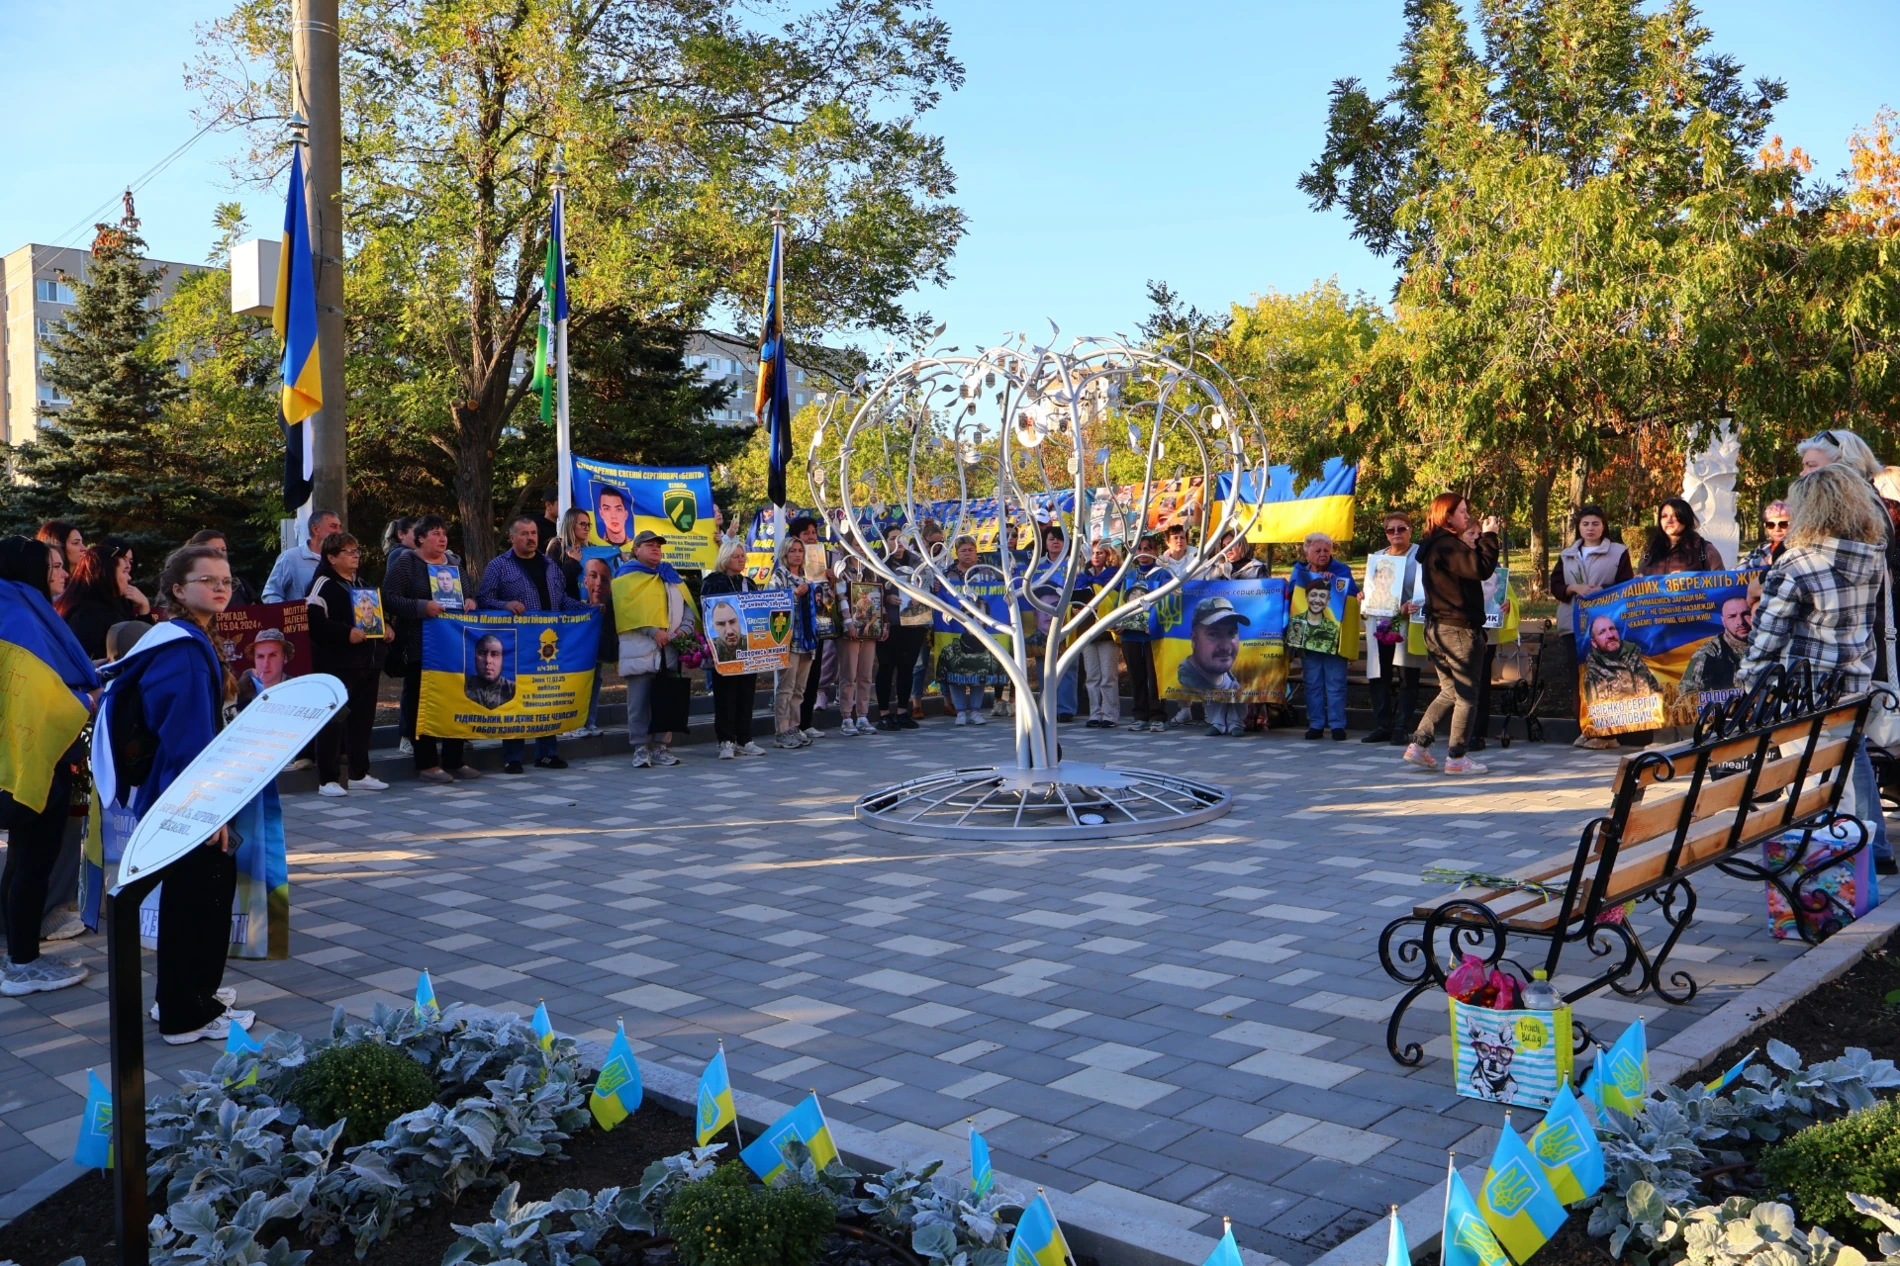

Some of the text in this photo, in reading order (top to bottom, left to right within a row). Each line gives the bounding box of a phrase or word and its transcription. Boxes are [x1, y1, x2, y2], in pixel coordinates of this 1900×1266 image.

[1665, 574, 1733, 593] ЗБЕРЕЖІТЬ
[1232, 588, 1254, 598] серце
[283, 605, 308, 616] МОЛТЯ
[216, 611, 248, 622] БРИГАДА
[284, 614, 309, 625] ВАЛЕНТ
[480, 615, 512, 624] Микола
[513, 614, 558, 625] Сергійович
[737, 648, 767, 659] Повернись
[1626, 694, 1659, 712] СЕРГІЙ
[504, 714, 514, 723] МИ
[535, 713, 550, 722] ТЕБЕ
[1592, 709, 1653, 730] МИХАЙЛОВИЧ
